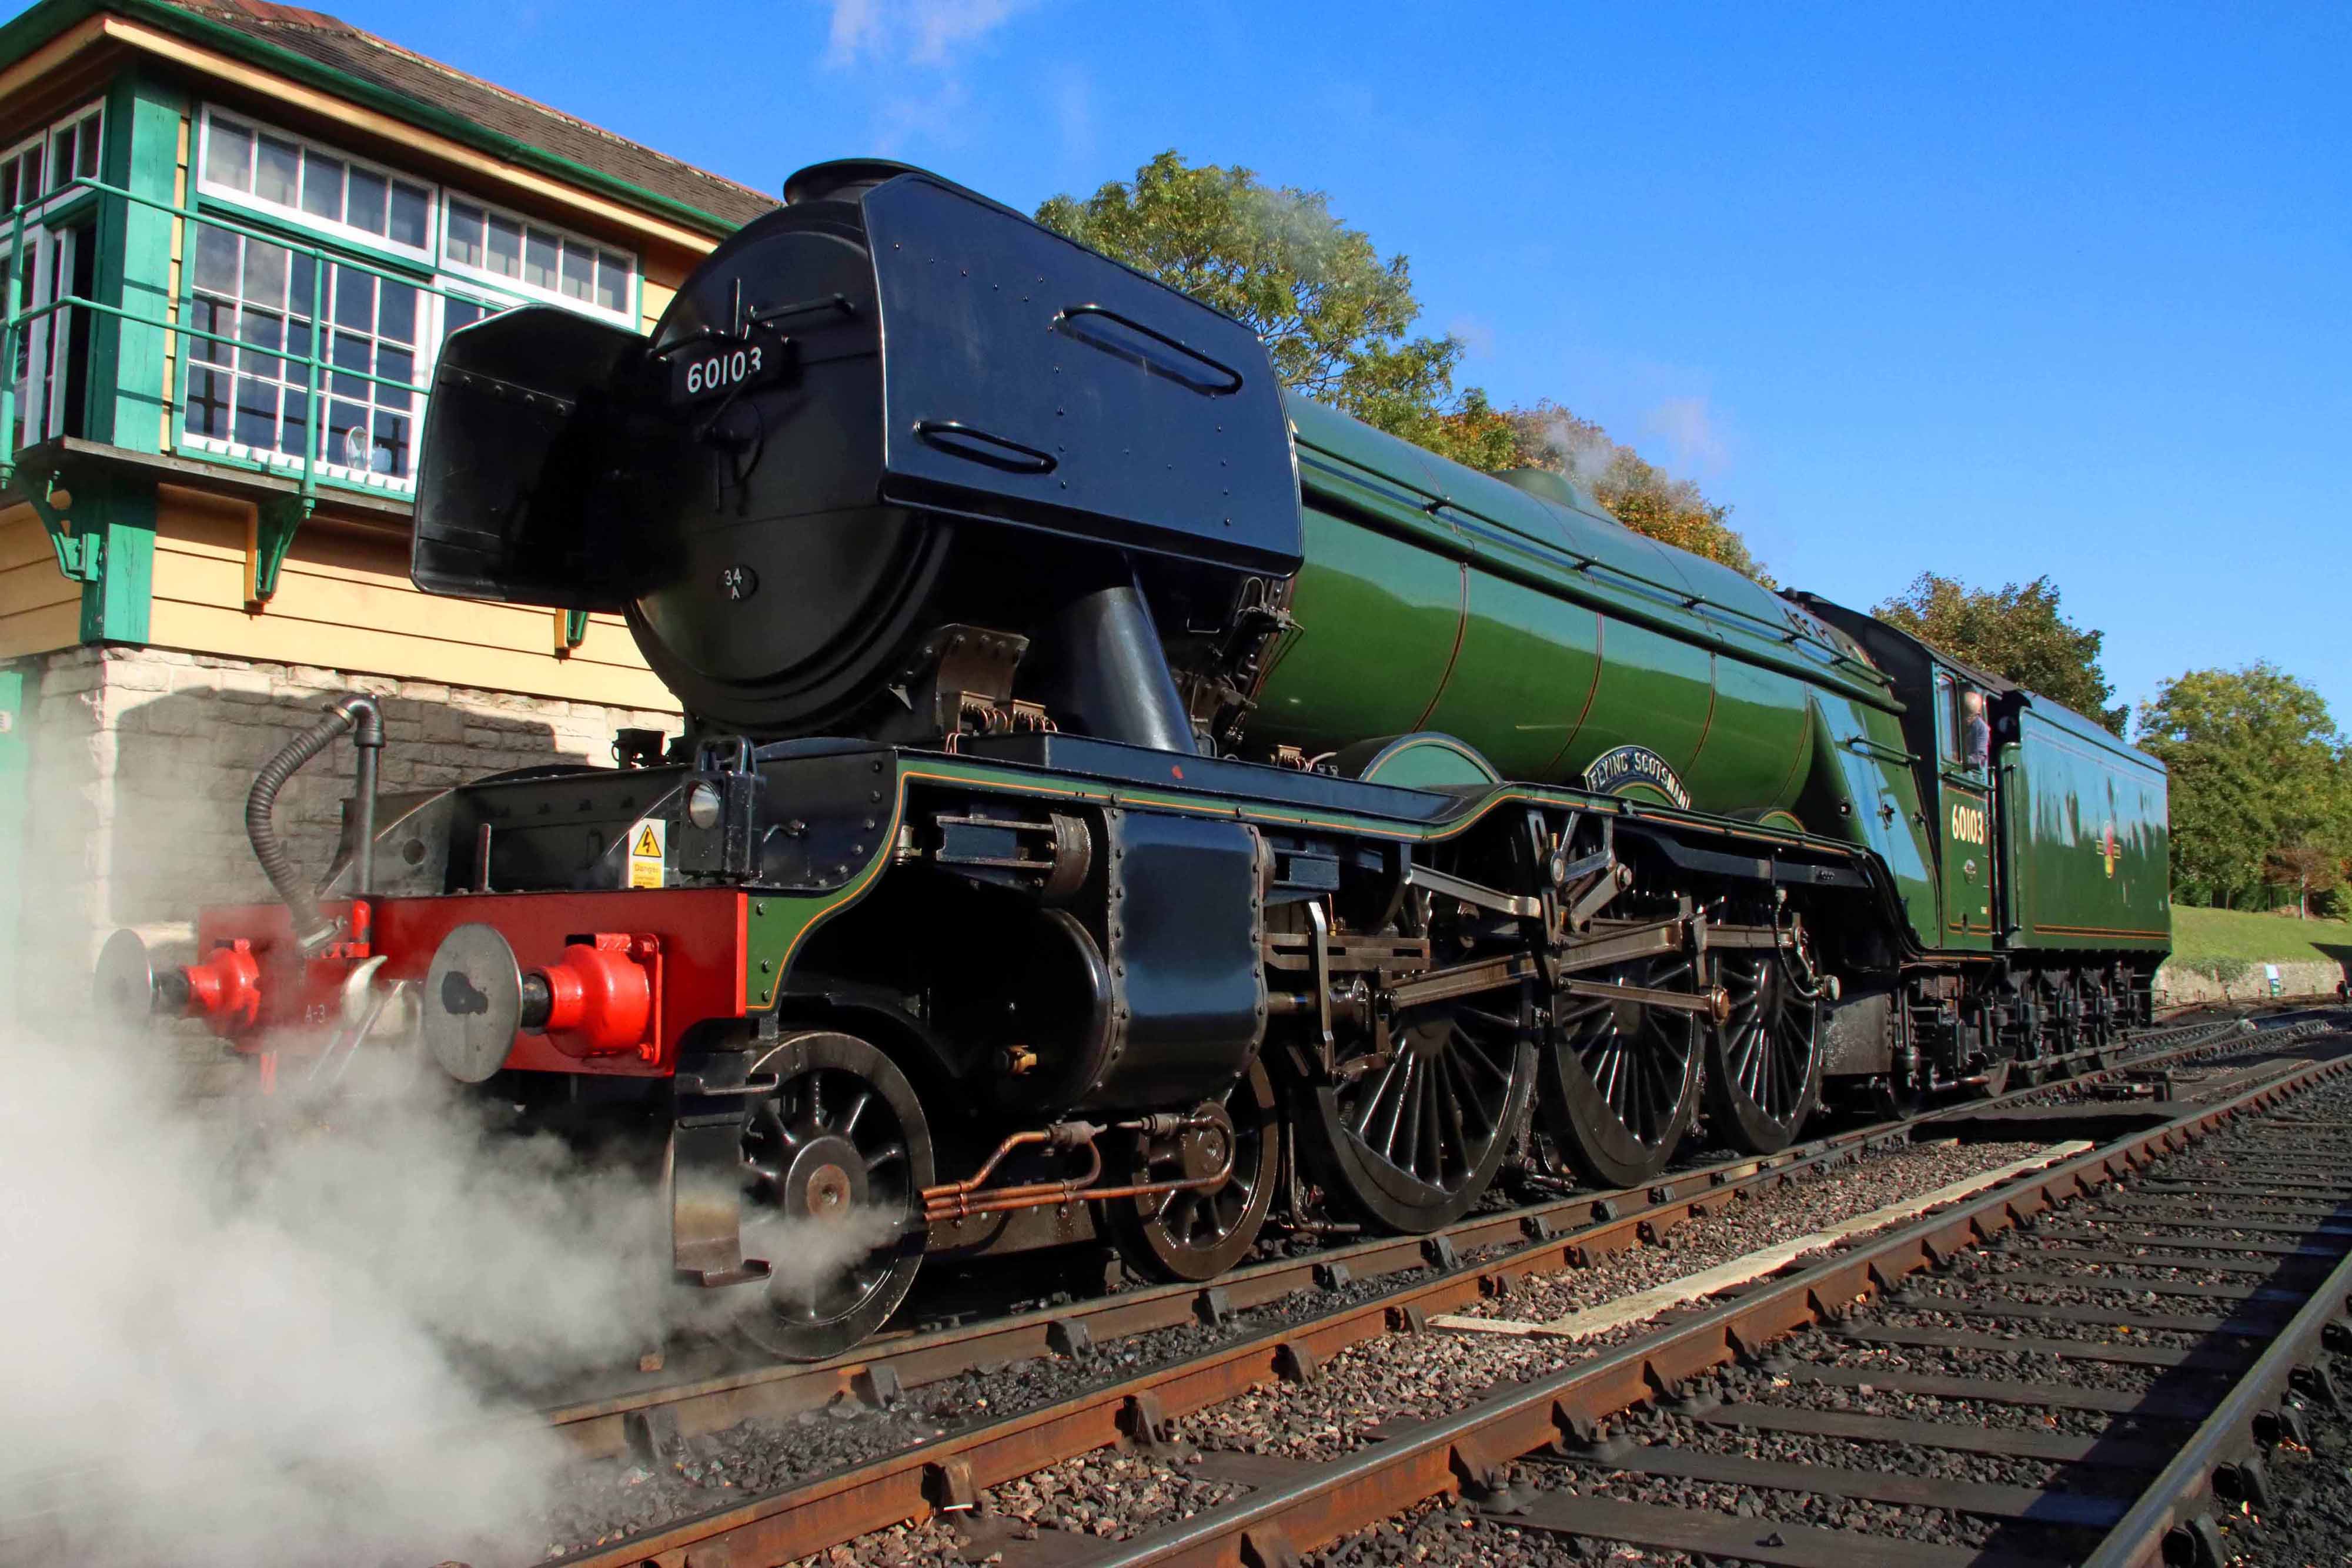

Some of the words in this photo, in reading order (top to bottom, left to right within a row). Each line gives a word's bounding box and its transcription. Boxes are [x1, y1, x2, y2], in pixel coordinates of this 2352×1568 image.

[687, 346, 762, 393] 60103
[724, 568, 743, 586] 34
[731, 585, 740, 600] A
[1589, 753, 1629, 792] FLYING
[1634, 752, 1686, 809] SCOTSMAN
[1952, 804, 1984, 845] 60103
